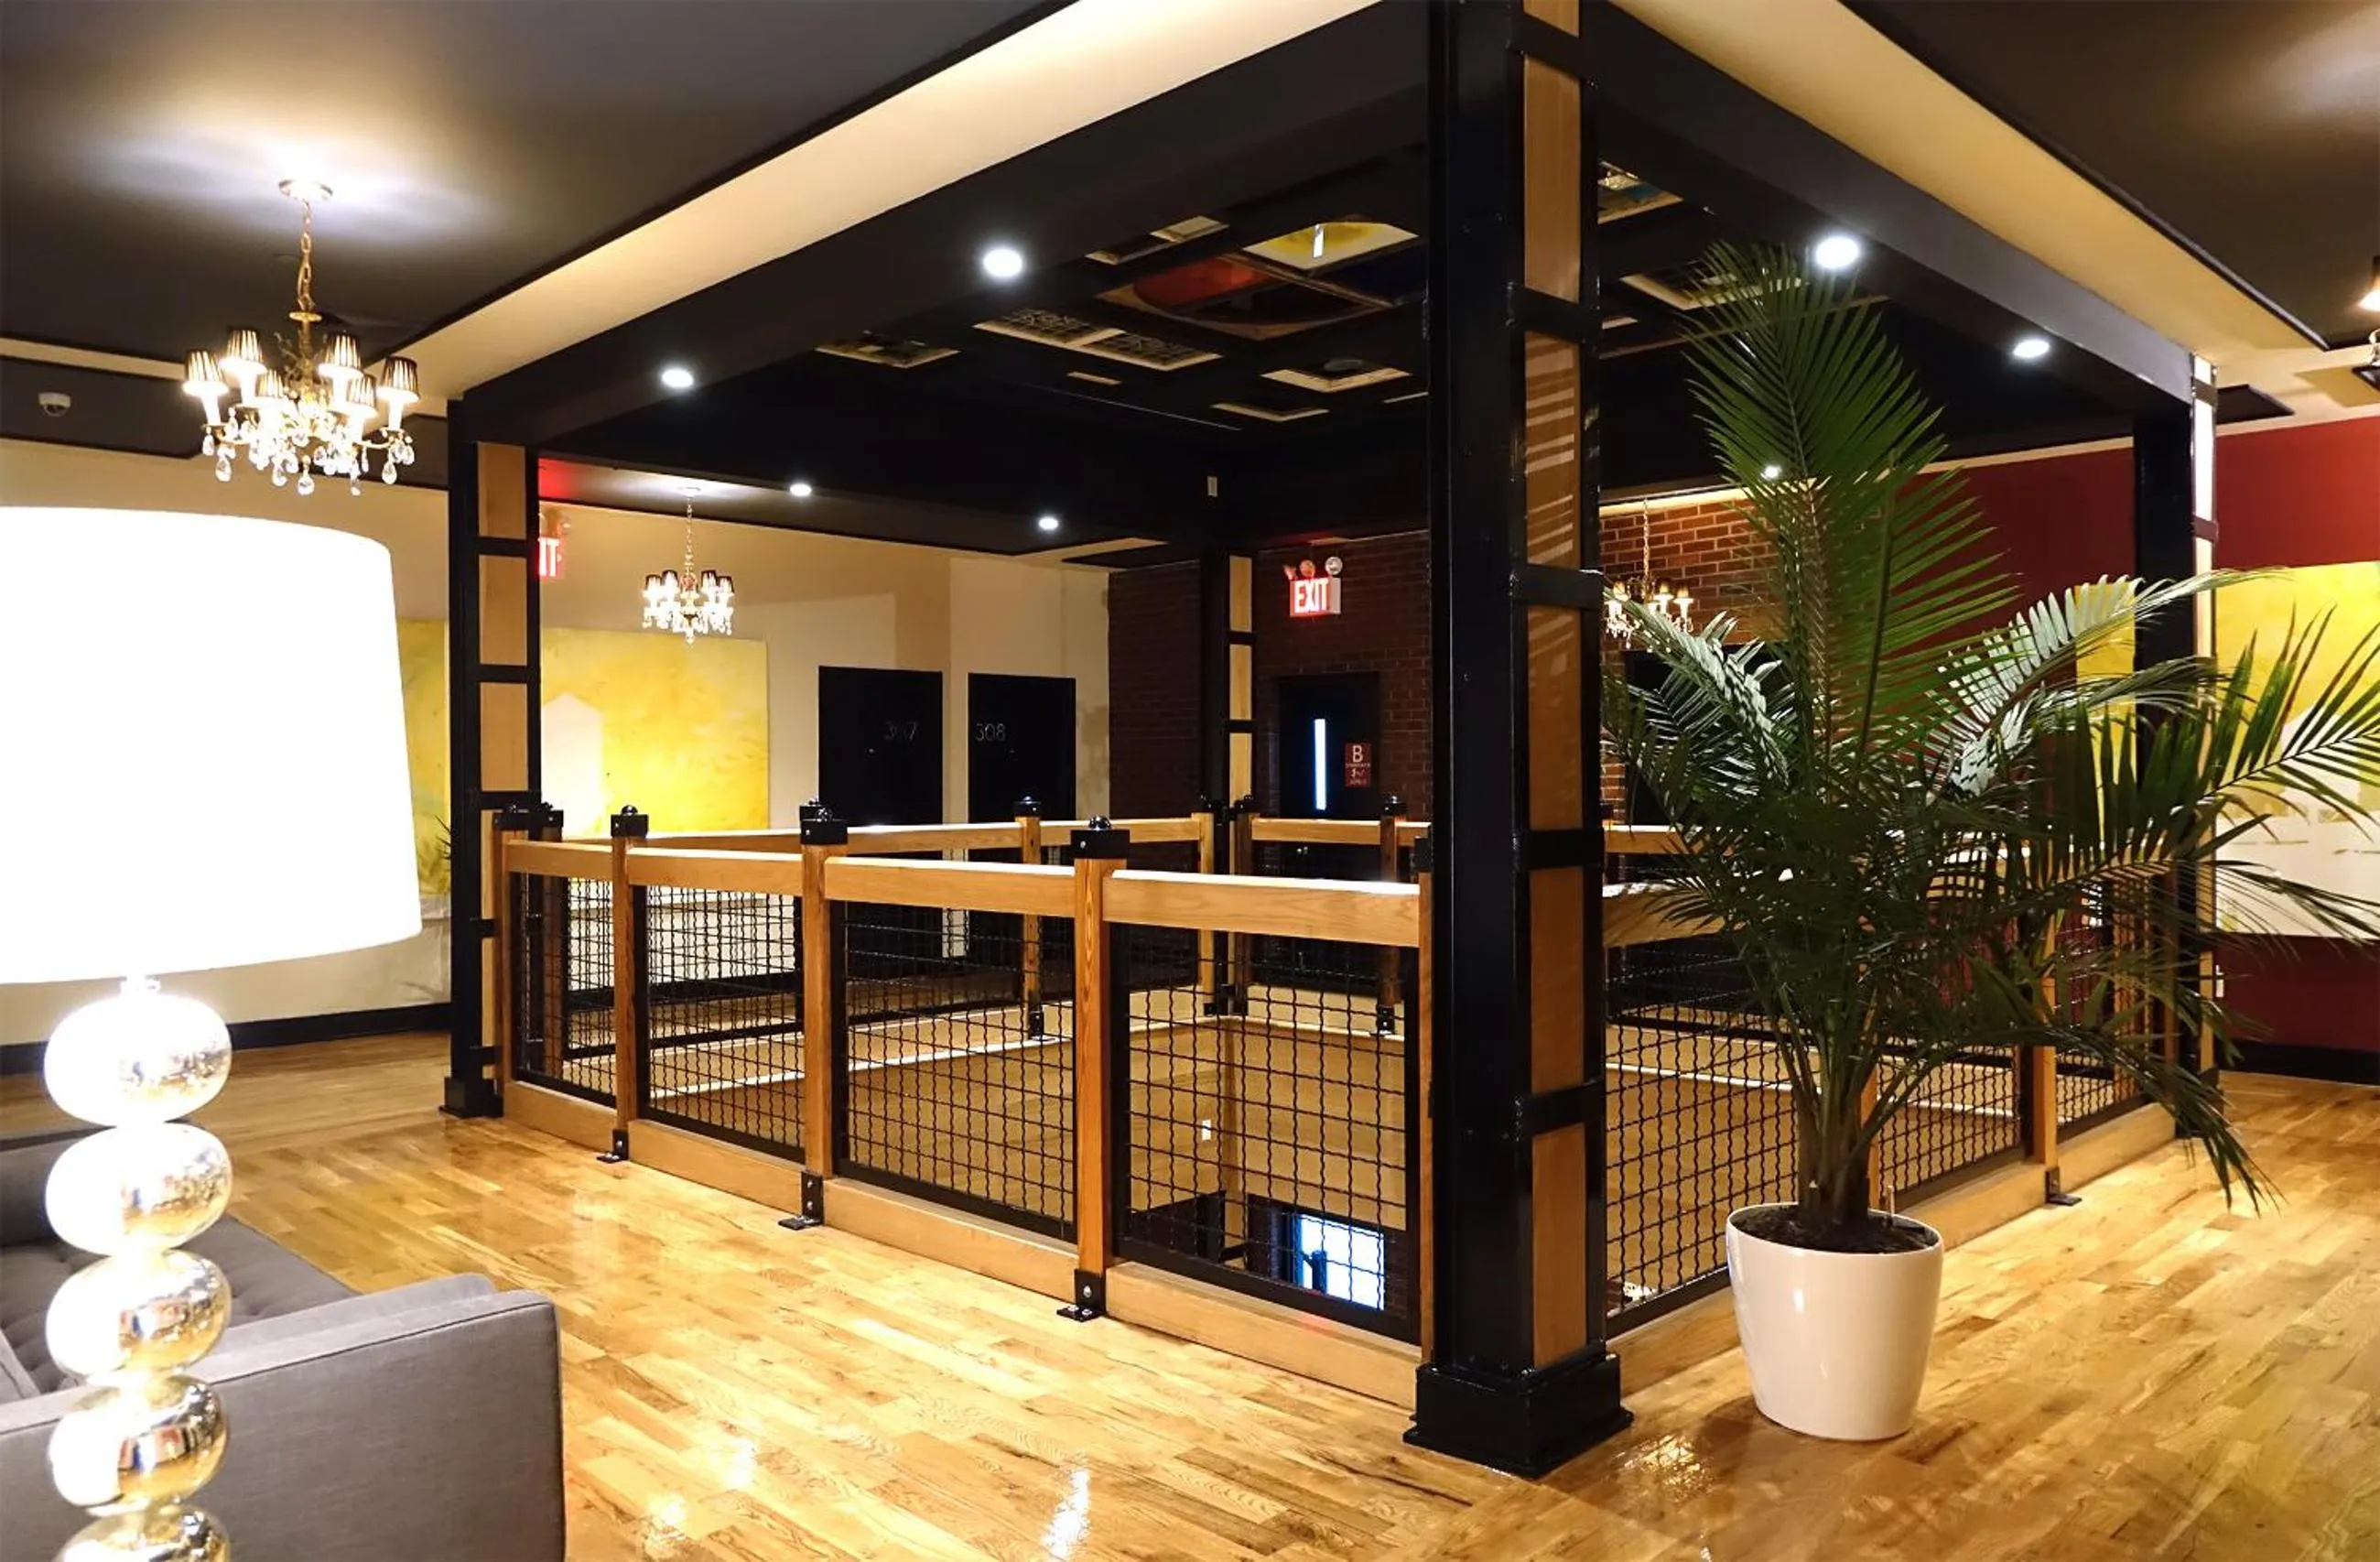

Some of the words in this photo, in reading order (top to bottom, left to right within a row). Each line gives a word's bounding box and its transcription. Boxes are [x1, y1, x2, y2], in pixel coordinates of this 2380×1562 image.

[1294, 578, 1329, 613] EXIT
[975, 722, 1006, 742] 308
[1352, 744, 1363, 763] B
